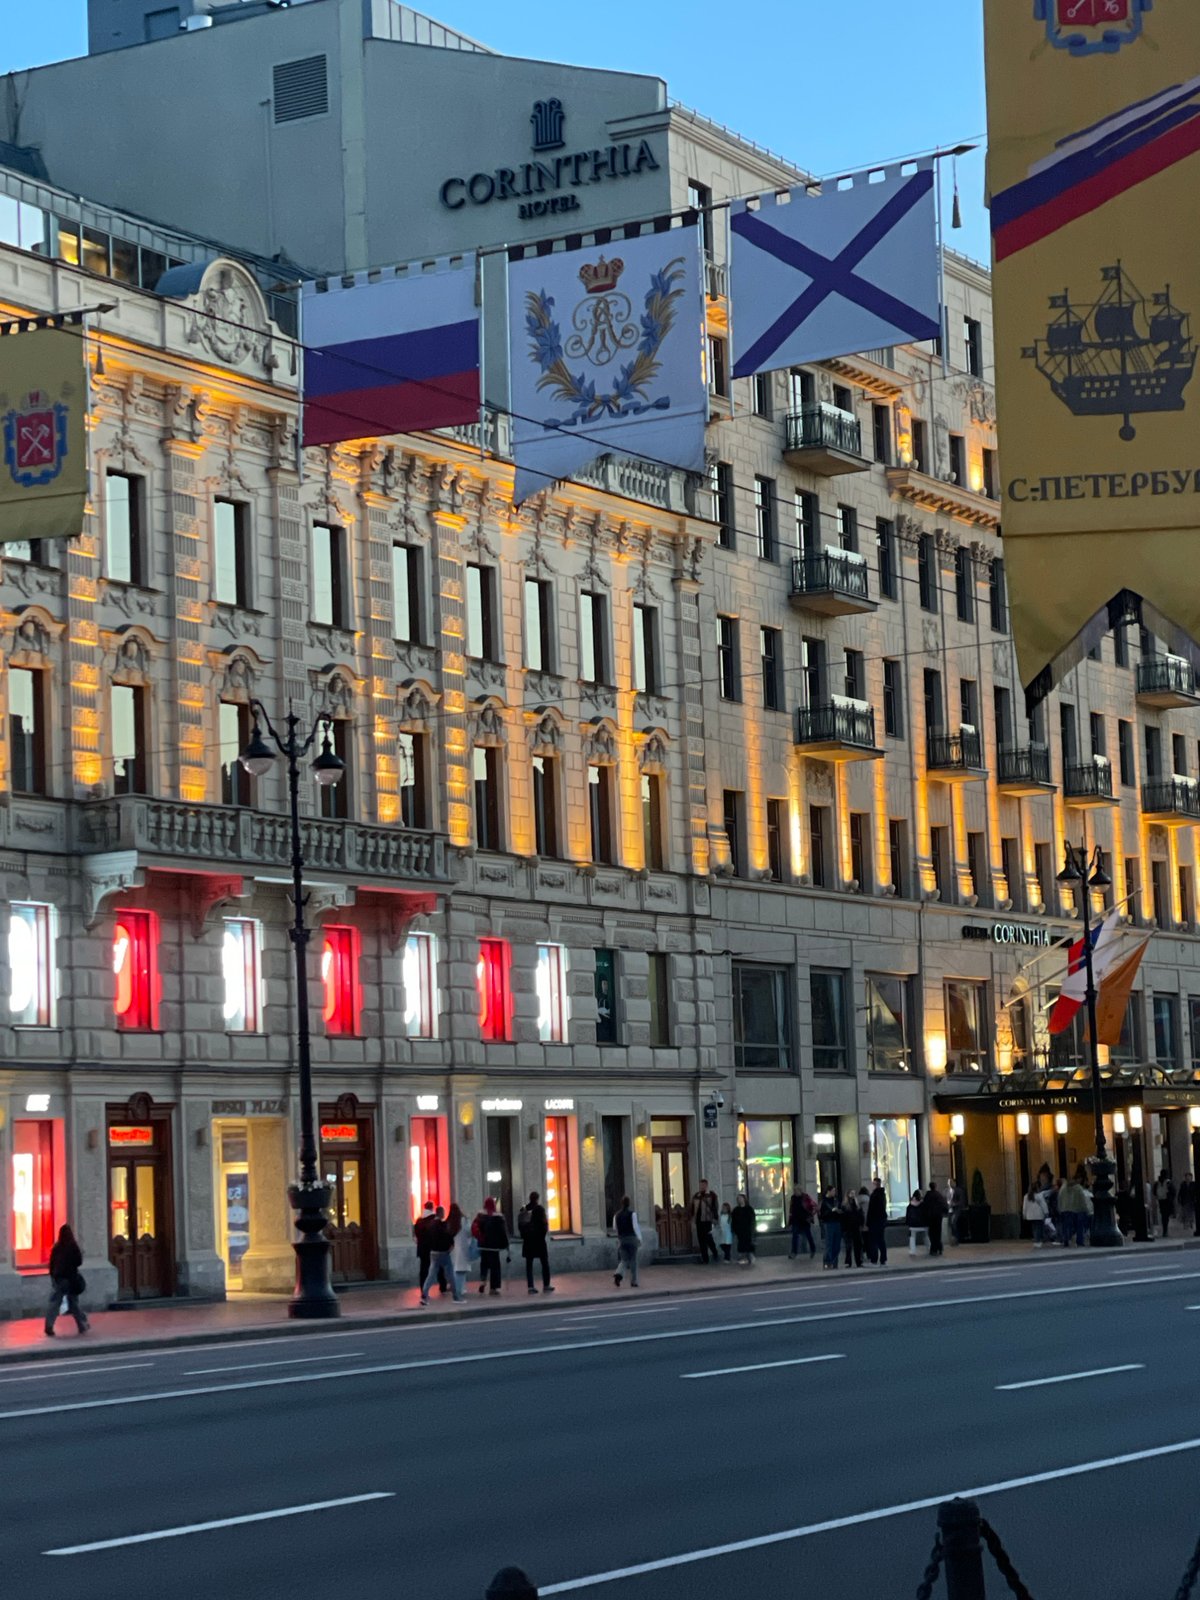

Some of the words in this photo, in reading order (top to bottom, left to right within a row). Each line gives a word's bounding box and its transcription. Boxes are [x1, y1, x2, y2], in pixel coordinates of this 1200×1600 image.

[439, 139, 660, 210] CORINTHIA
[517, 193, 580, 220] HOTEL
[993, 923, 1051, 947] CORINTHIA
[999, 1097, 1046, 1107] CORINTHIA
[1050, 1096, 1079, 1105] HOTEL
